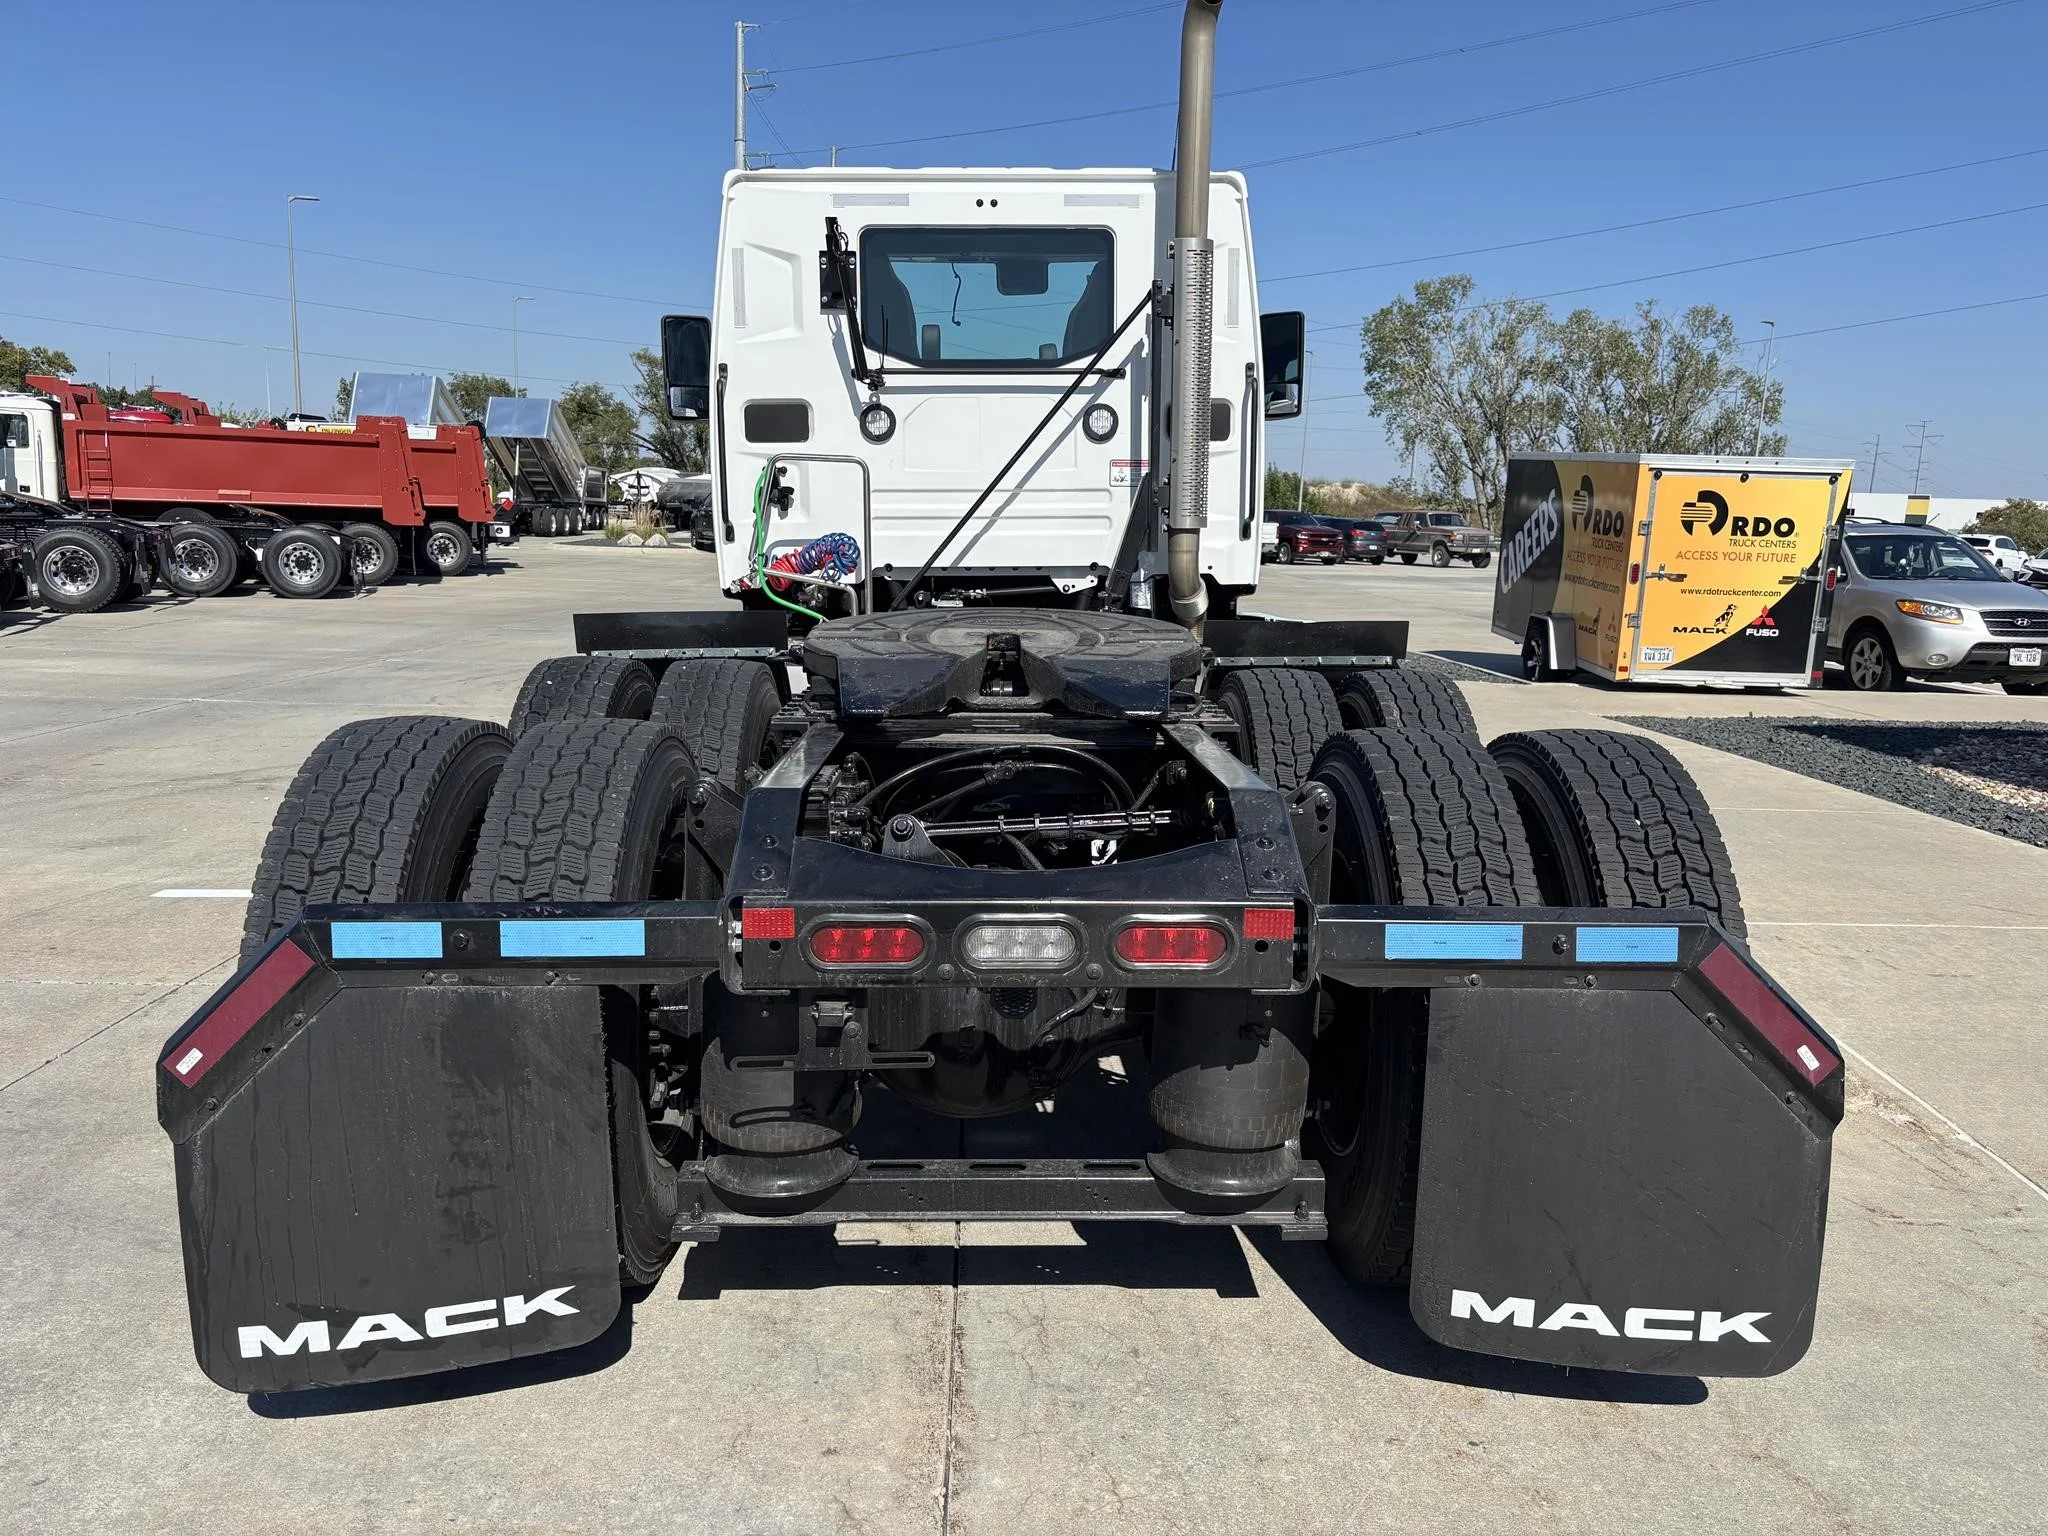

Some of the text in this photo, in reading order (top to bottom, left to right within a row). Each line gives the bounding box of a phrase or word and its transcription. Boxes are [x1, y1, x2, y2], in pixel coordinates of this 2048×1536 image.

[1593, 508, 1625, 538] RDO
[1731, 516, 1796, 538] RDO
[1500, 488, 1558, 594] CAREERS
[1729, 538, 1797, 549] TRUCK CENTERS
[1676, 550, 1797, 563] ACCESS YOUR FUTURE
[1680, 587, 1782, 598] www.rdotruckcenter.com
[1578, 624, 1598, 636] MACK
[1673, 626, 1728, 635] MACK
[1745, 628, 1779, 637] FUSO
[238, 1285, 580, 1358] MACK
[1451, 1289, 1772, 1343] MACK
